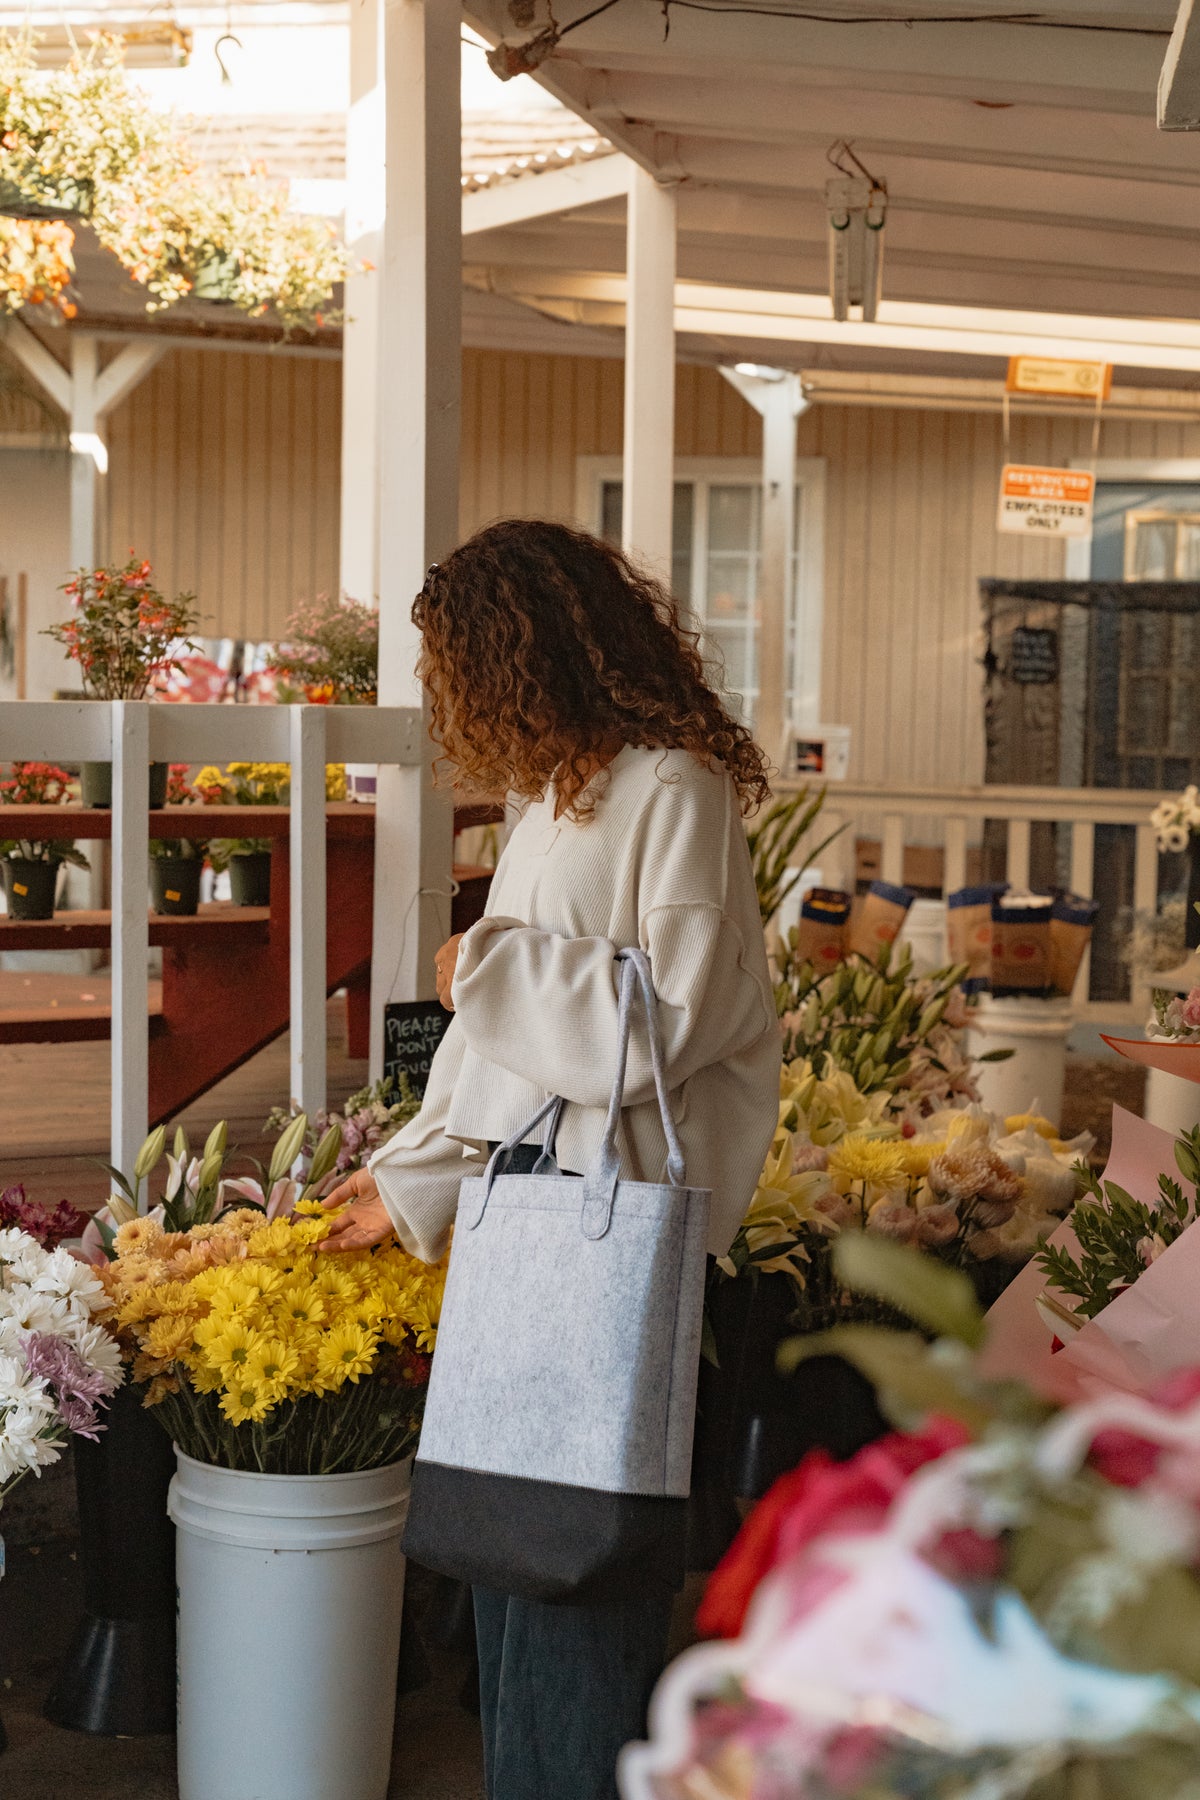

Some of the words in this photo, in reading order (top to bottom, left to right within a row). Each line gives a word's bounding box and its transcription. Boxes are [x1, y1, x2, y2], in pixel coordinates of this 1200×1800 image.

[1006, 501, 1084, 516] EMPLOYEES
[1027, 516, 1060, 529] ONLY
[396, 1034, 440, 1056] DON'T
[385, 1059, 433, 1078] TOUC
